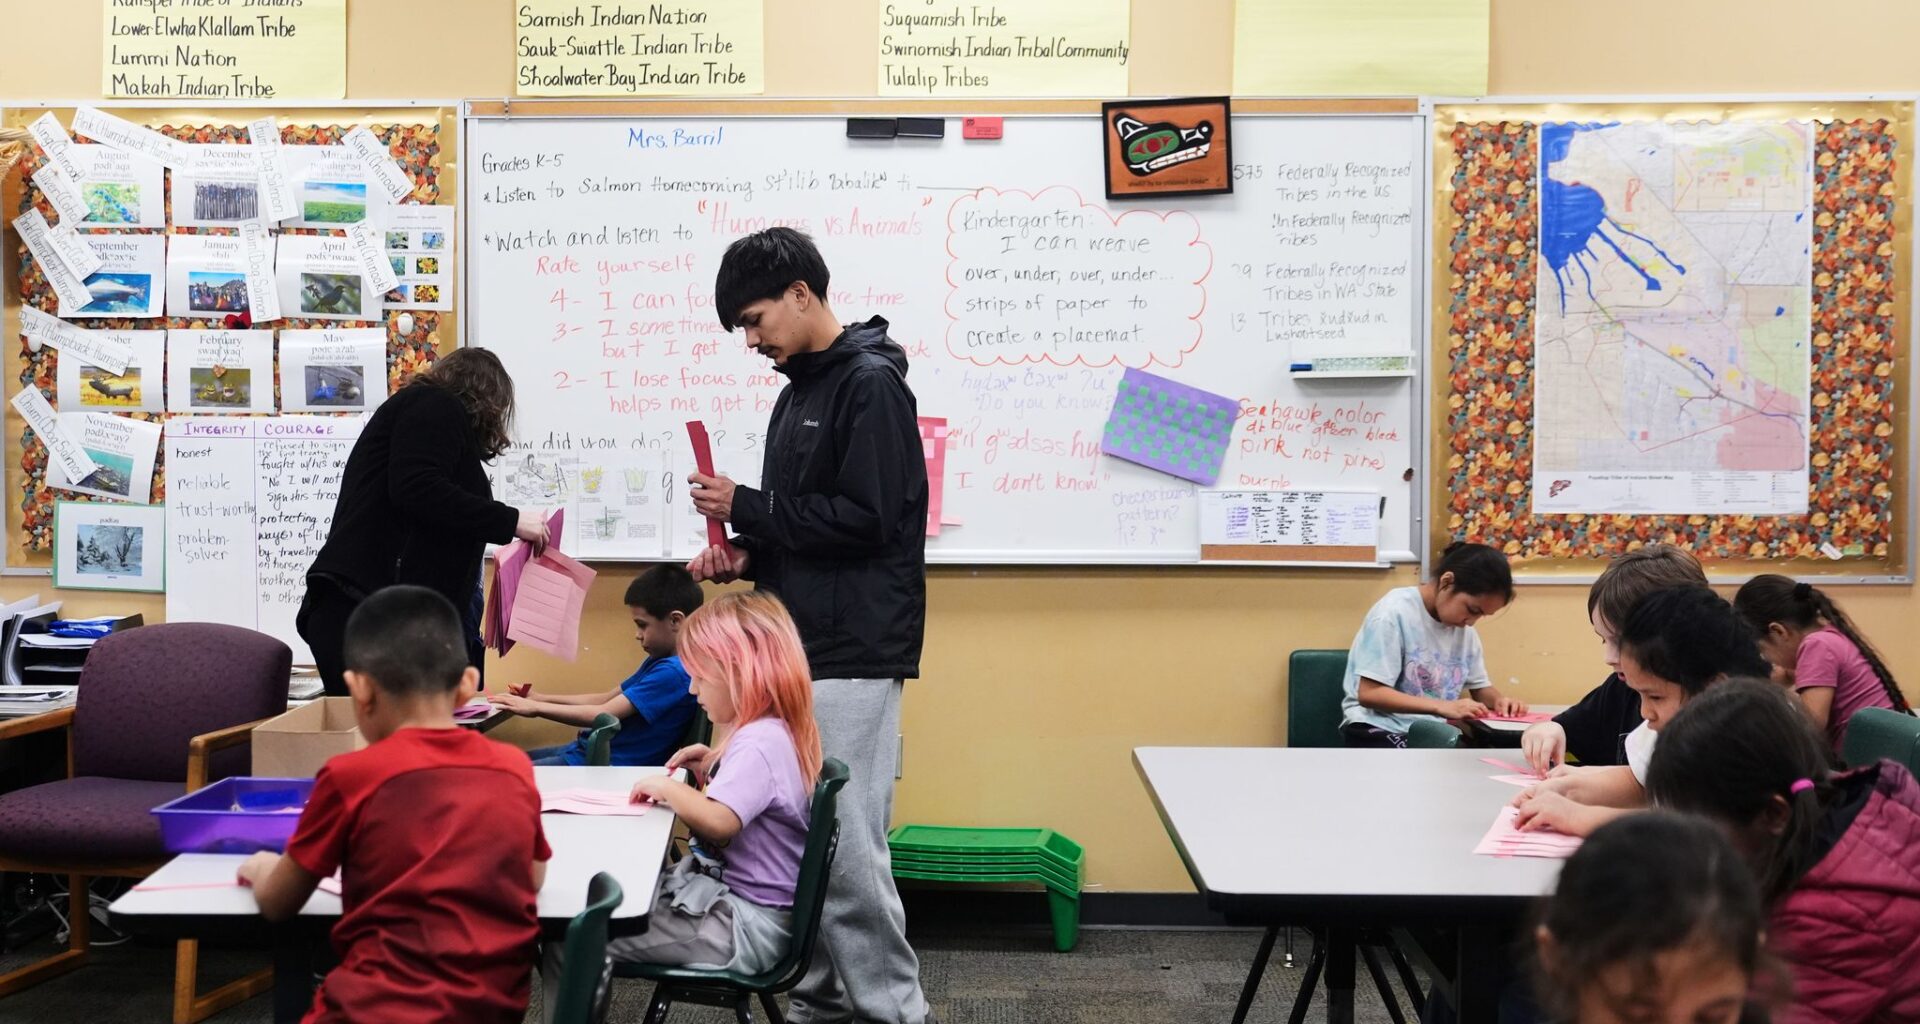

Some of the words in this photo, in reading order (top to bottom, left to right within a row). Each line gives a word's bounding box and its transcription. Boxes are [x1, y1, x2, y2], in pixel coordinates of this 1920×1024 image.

[518, 6, 584, 27] Samish
[590, 5, 645, 27] Indian
[649, 4, 707, 25] Nation
[884, 5, 965, 35] Suquamish
[970, 6, 1007, 27] Tribe
[112, 16, 153, 36] Lower
[155, 17, 197, 36] Elwha
[199, 16, 255, 37] Klallam
[257, 16, 296, 37] Tribe
[112, 45, 169, 66] Lummi
[176, 45, 237, 66] Nation
[518, 36, 626, 57] Sauk-Suiattle
[631, 34, 687, 56] Indian
[691, 33, 734, 54] Tribe
[882, 36, 961, 57] Swinomish
[965, 36, 1012, 57] Indian
[1014, 36, 1056, 57] Tribal
[1057, 37, 1129, 65] Community
[113, 73, 170, 95] Makah
[176, 75, 229, 98] Indian
[231, 74, 276, 98] Tribe
[519, 65, 605, 87] Shoalwater
[604, 63, 637, 92] Bay
[638, 64, 700, 86] Indian
[703, 62, 747, 84] Tribe
[885, 64, 938, 93] Tulalip
[942, 64, 989, 86] Tribes
[628, 127, 668, 149] Mrs.
[673, 126, 723, 147] Barril
[482, 152, 530, 174] Grades
[536, 153, 565, 168] K-5
[1278, 163, 1340, 187] Federally
[1344, 161, 1413, 185] Recognized
[546, 181, 565, 198] to
[579, 178, 642, 193] Salmon
[651, 176, 754, 202] Homecoming
[1275, 188, 1320, 202] Tribes
[1328, 190, 1341, 199] in
[1344, 185, 1367, 199] the
[1374, 185, 1392, 199] US
[1352, 207, 1413, 238] Recognized
[567, 226, 609, 245] and
[673, 225, 693, 240] to
[1001, 235, 1016, 254] I
[1034, 235, 1077, 250] can
[1089, 237, 1151, 254] weave
[88, 240, 140, 254] September
[202, 240, 240, 255] January
[319, 240, 347, 256] April
[537, 256, 580, 276] Rate
[597, 253, 695, 285] yourself
[1014, 265, 1061, 284] under,
[1266, 262, 1326, 289] Federally
[1330, 260, 1407, 287] Recognized
[599, 291, 617, 310] I
[633, 292, 674, 310] can
[1262, 285, 1313, 301] Tribes
[1319, 287, 1332, 299] in
[1335, 283, 1357, 299] WA
[1363, 282, 1398, 298] State
[966, 297, 1017, 317] strips
[1026, 294, 1044, 312] of
[1056, 299, 1111, 320] paper
[1128, 295, 1148, 310] to
[1258, 308, 1311, 328] Tribes
[599, 320, 619, 338] I
[967, 325, 1024, 348] create
[1034, 331, 1042, 341] a
[603, 339, 646, 359] but
[664, 340, 680, 356] I
[692, 339, 721, 364] get
[600, 371, 619, 389] I
[634, 369, 670, 387] lose
[678, 367, 737, 389] focus
[747, 370, 780, 388] and
[610, 395, 662, 421] helps
[671, 397, 700, 412] me
[711, 395, 745, 422] get
[85, 414, 135, 436] November
[184, 422, 246, 436] INTEGRITY
[264, 422, 335, 436] COURAGE
[176, 446, 214, 461] honest
[324, 440, 347, 452] sign
[1303, 445, 1335, 463] not
[260, 458, 296, 479] fought
[177, 472, 231, 491] reliable
[993, 471, 1045, 494] don't
[266, 490, 288, 512] sign
[259, 512, 318, 532] protecting
[185, 545, 229, 564] solver
[273, 557, 306, 573] horses
